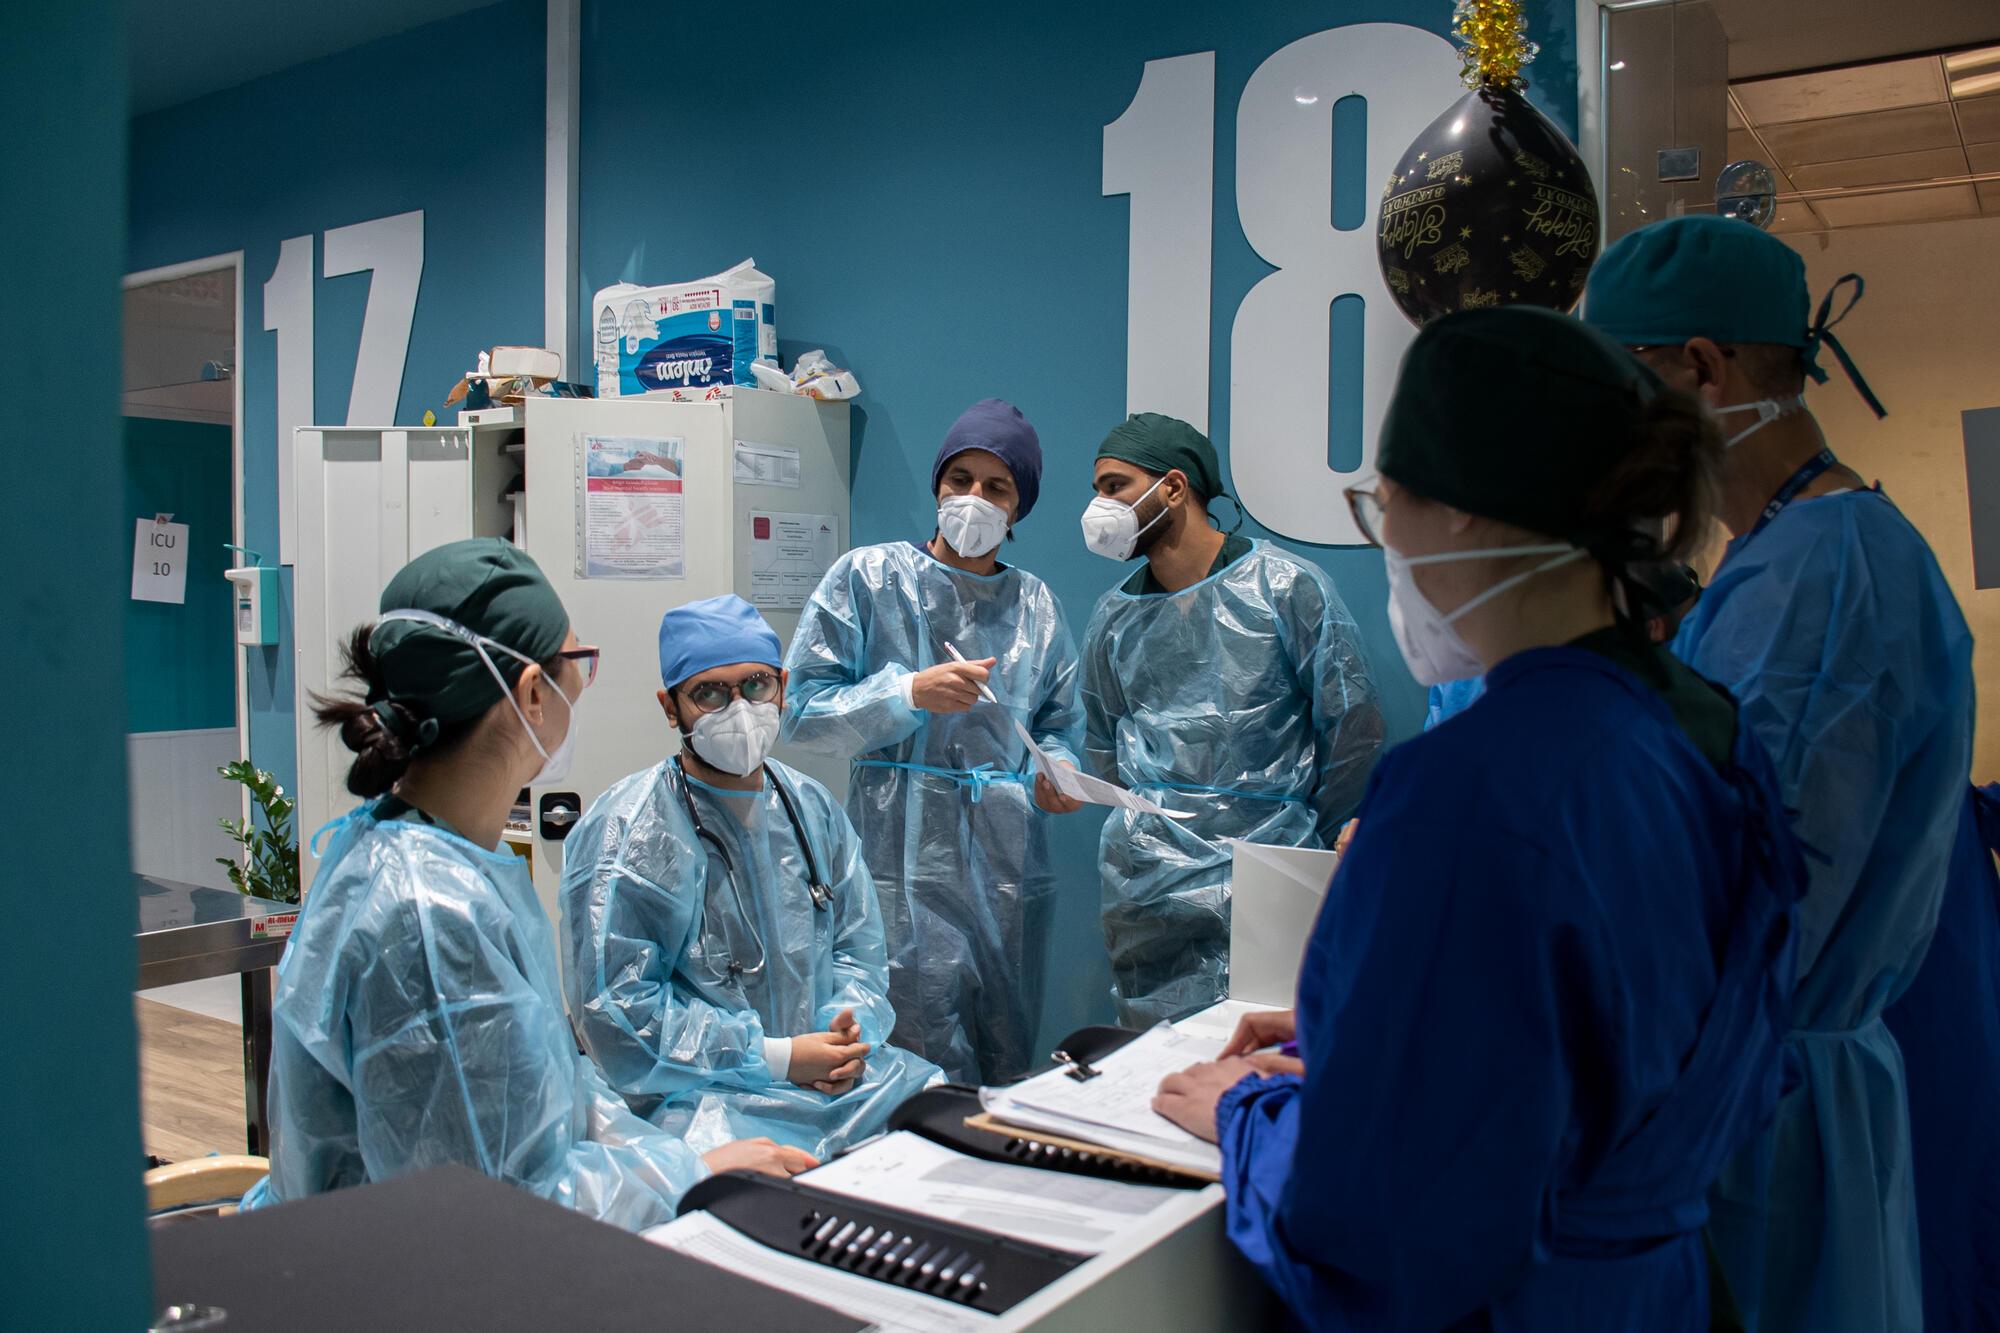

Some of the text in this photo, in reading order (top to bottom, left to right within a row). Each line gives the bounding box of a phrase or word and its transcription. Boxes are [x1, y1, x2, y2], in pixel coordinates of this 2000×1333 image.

[1379, 204, 1446, 260] Happy
[1521, 199, 1595, 259] Happy
[1102, 22, 1467, 547] 18
[263, 209, 425, 566] 17
[150, 533, 176, 549] ICU
[152, 561, 171, 577] 10
